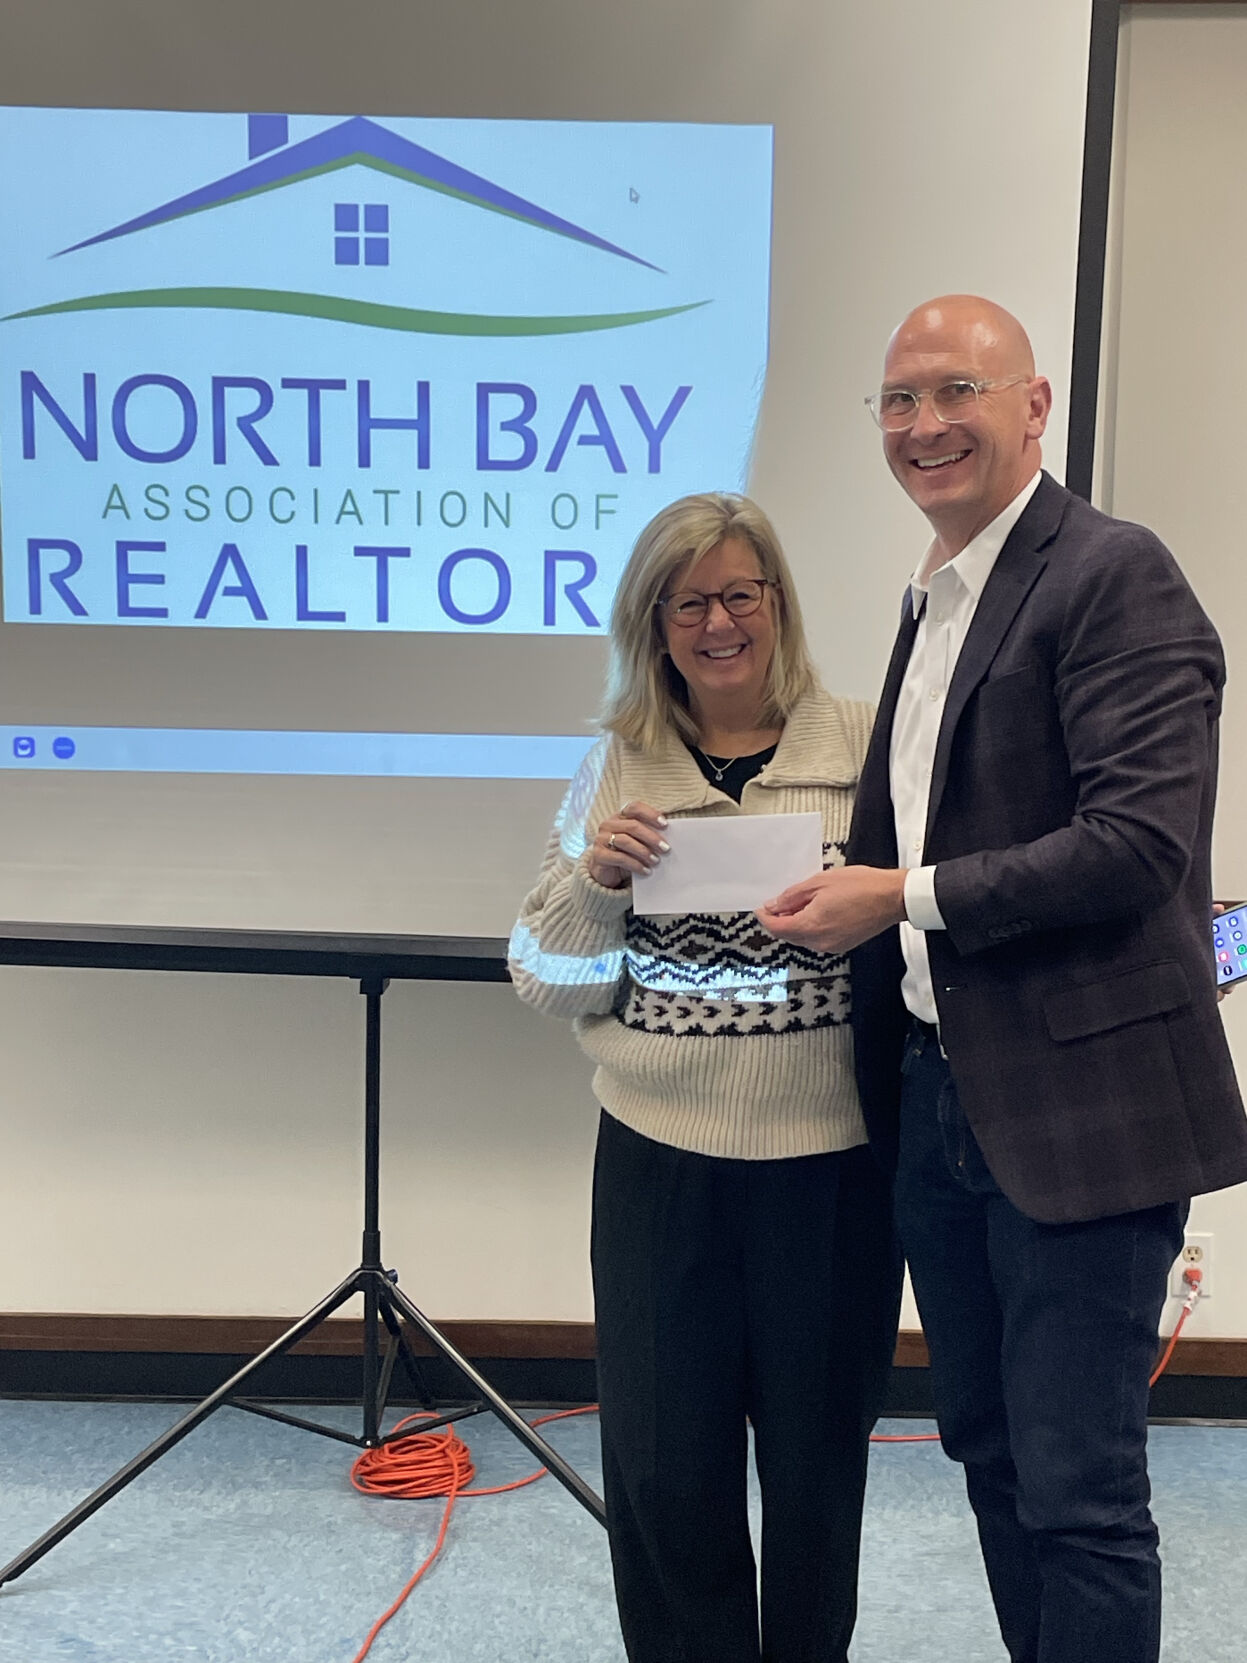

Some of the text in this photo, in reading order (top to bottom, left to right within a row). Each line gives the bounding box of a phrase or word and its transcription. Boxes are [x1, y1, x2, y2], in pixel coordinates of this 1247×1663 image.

[20, 370, 693, 474] NORTH BAY
[102, 484, 619, 530] ASSOCIATION OF
